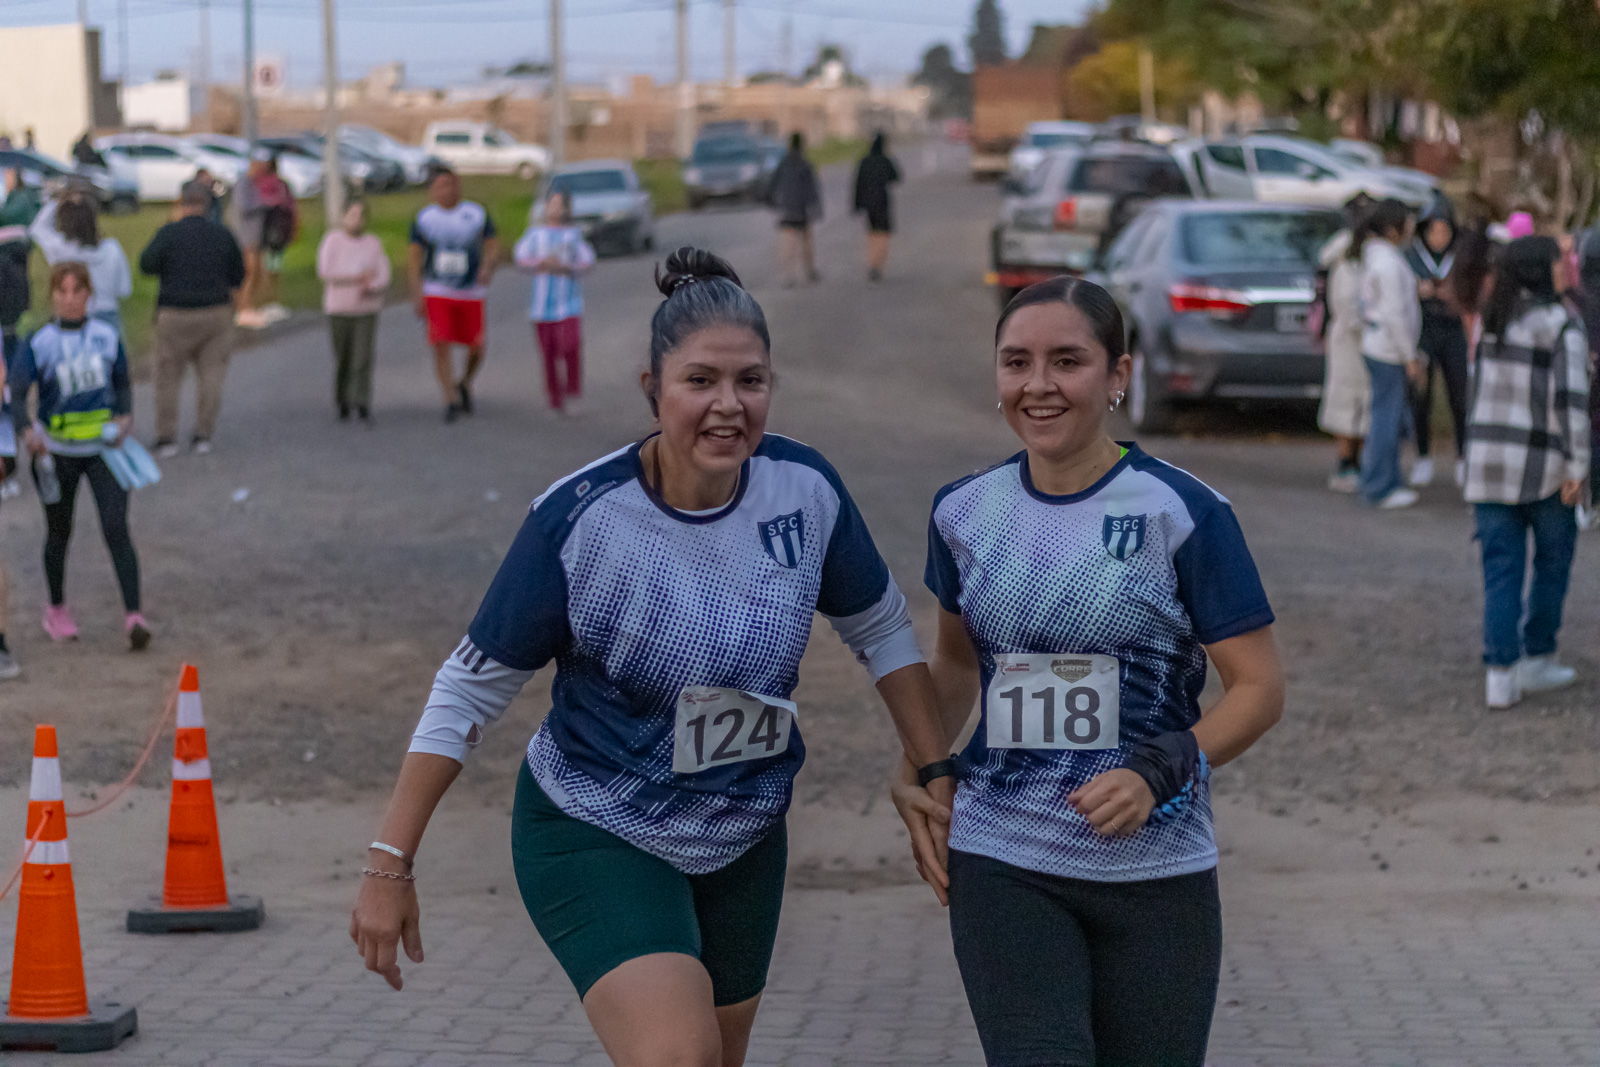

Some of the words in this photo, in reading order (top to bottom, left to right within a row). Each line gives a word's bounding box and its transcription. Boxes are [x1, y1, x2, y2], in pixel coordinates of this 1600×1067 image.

[768, 516, 798, 536] SFC
[1111, 519, 1139, 531] SFC
[1053, 665, 1091, 673] CORRE
[999, 686, 1101, 745] 118
[686, 703, 781, 767] 124
